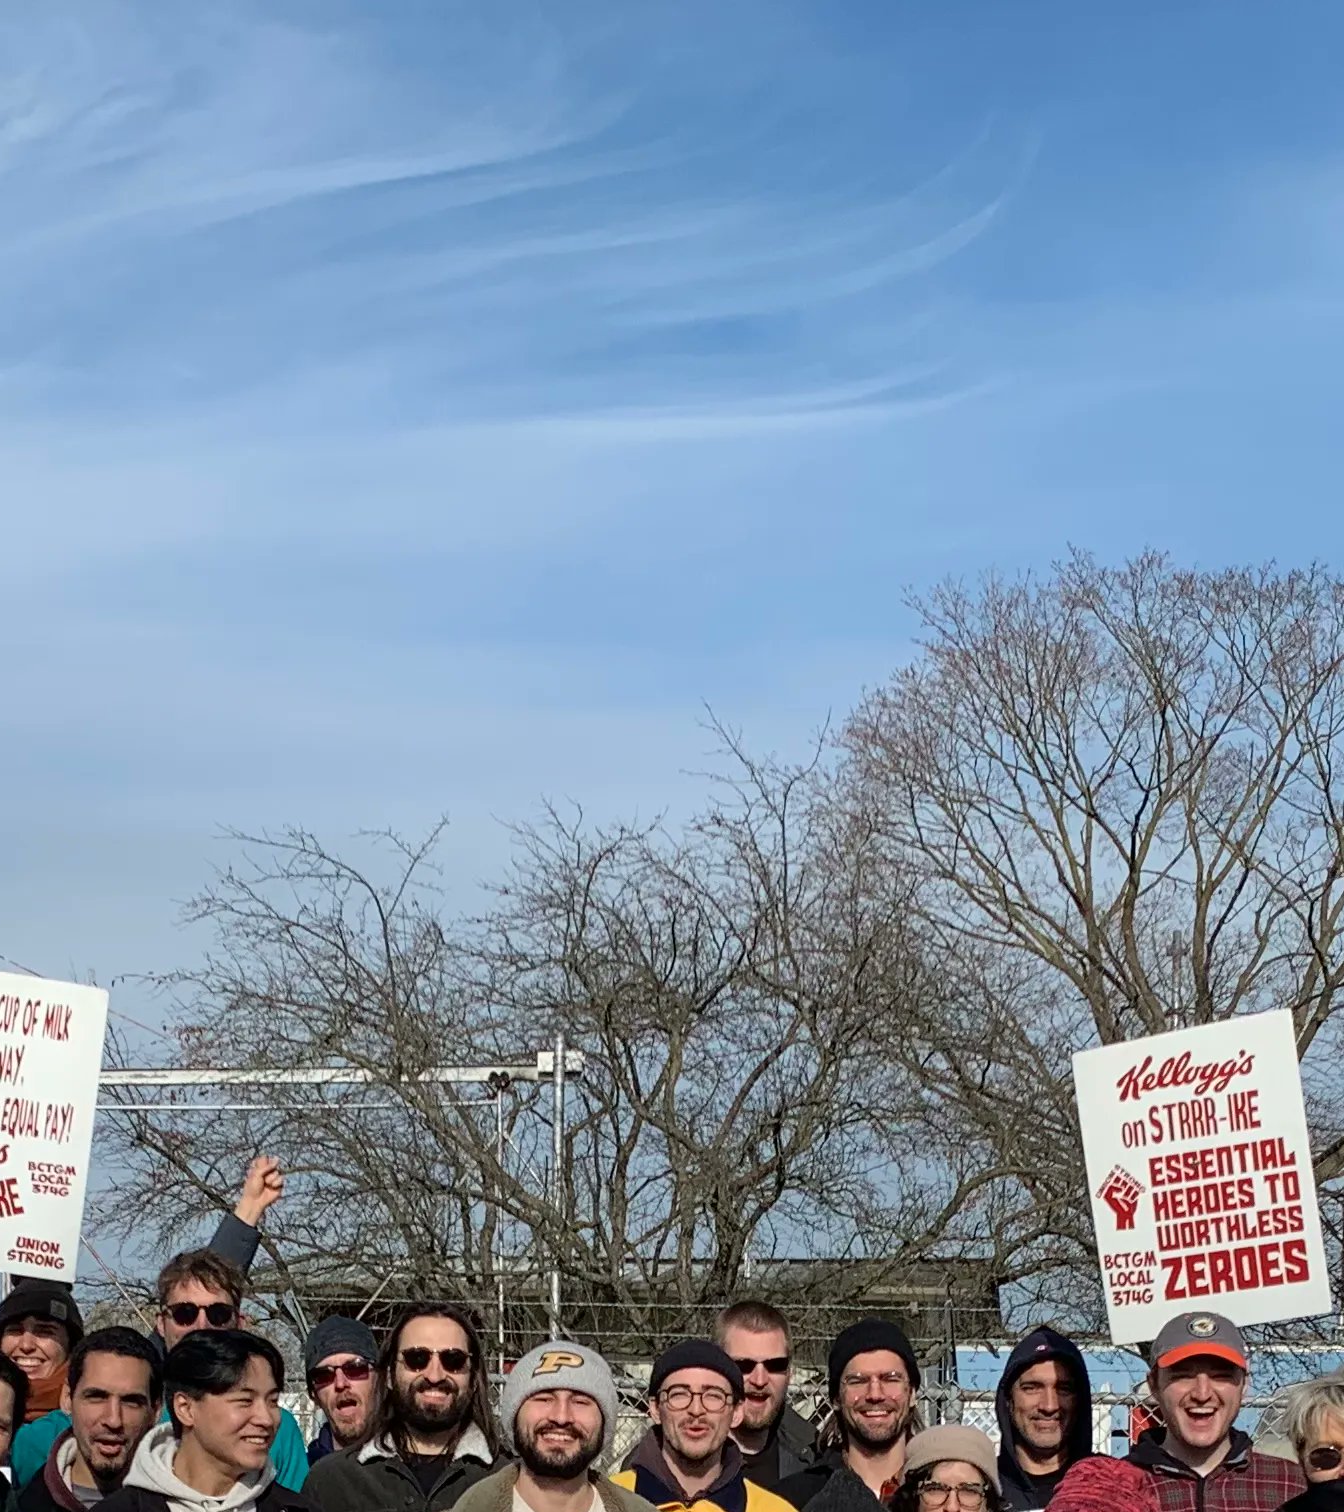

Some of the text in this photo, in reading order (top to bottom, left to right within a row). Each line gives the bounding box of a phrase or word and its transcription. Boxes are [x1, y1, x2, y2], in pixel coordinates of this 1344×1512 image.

[22, 999, 41, 1037] OF
[43, 1003, 73, 1041] MILK
[1116, 1050, 1255, 1101] Kellogg's
[0, 1097, 40, 1139] EQUAL
[43, 1102, 74, 1145] PAY!
[1122, 1090, 1262, 1148] on STRRR-IKE
[28, 1161, 76, 1176] BCTGM
[1148, 1137, 1296, 1188] ESSENTIAL
[31, 1172, 72, 1186] LOCAL
[32, 1184, 69, 1197] 374G
[1152, 1171, 1301, 1222] HEROES TO
[1156, 1205, 1305, 1252] WORTHLESS
[7, 1249, 65, 1269] STRONG
[16, 1236, 60, 1254] UNION
[1104, 1250, 1157, 1270] BCTGM
[1161, 1239, 1310, 1301] ZEROES
[1109, 1271, 1154, 1288] LOCAL
[1113, 1288, 1154, 1306] 374G
[532, 1350, 585, 1379] P
